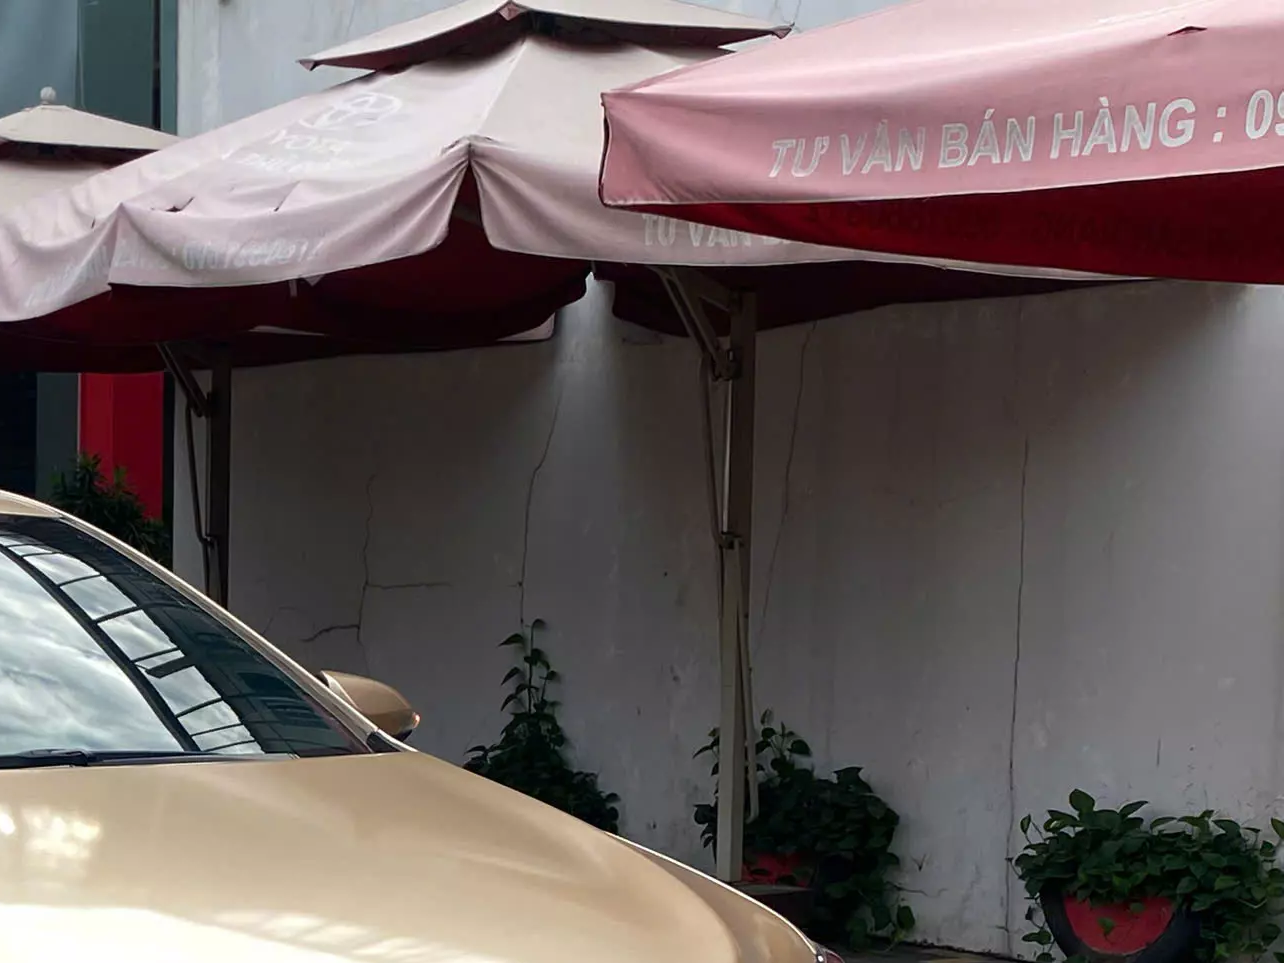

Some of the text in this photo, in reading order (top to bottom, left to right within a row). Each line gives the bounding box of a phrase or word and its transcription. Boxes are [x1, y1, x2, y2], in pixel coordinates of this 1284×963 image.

[769, 136, 830, 178] TƯ
[937, 108, 1036, 168] BÁN
[1050, 96, 1196, 159] HÀNG
[1212, 106, 1227, 143] :
